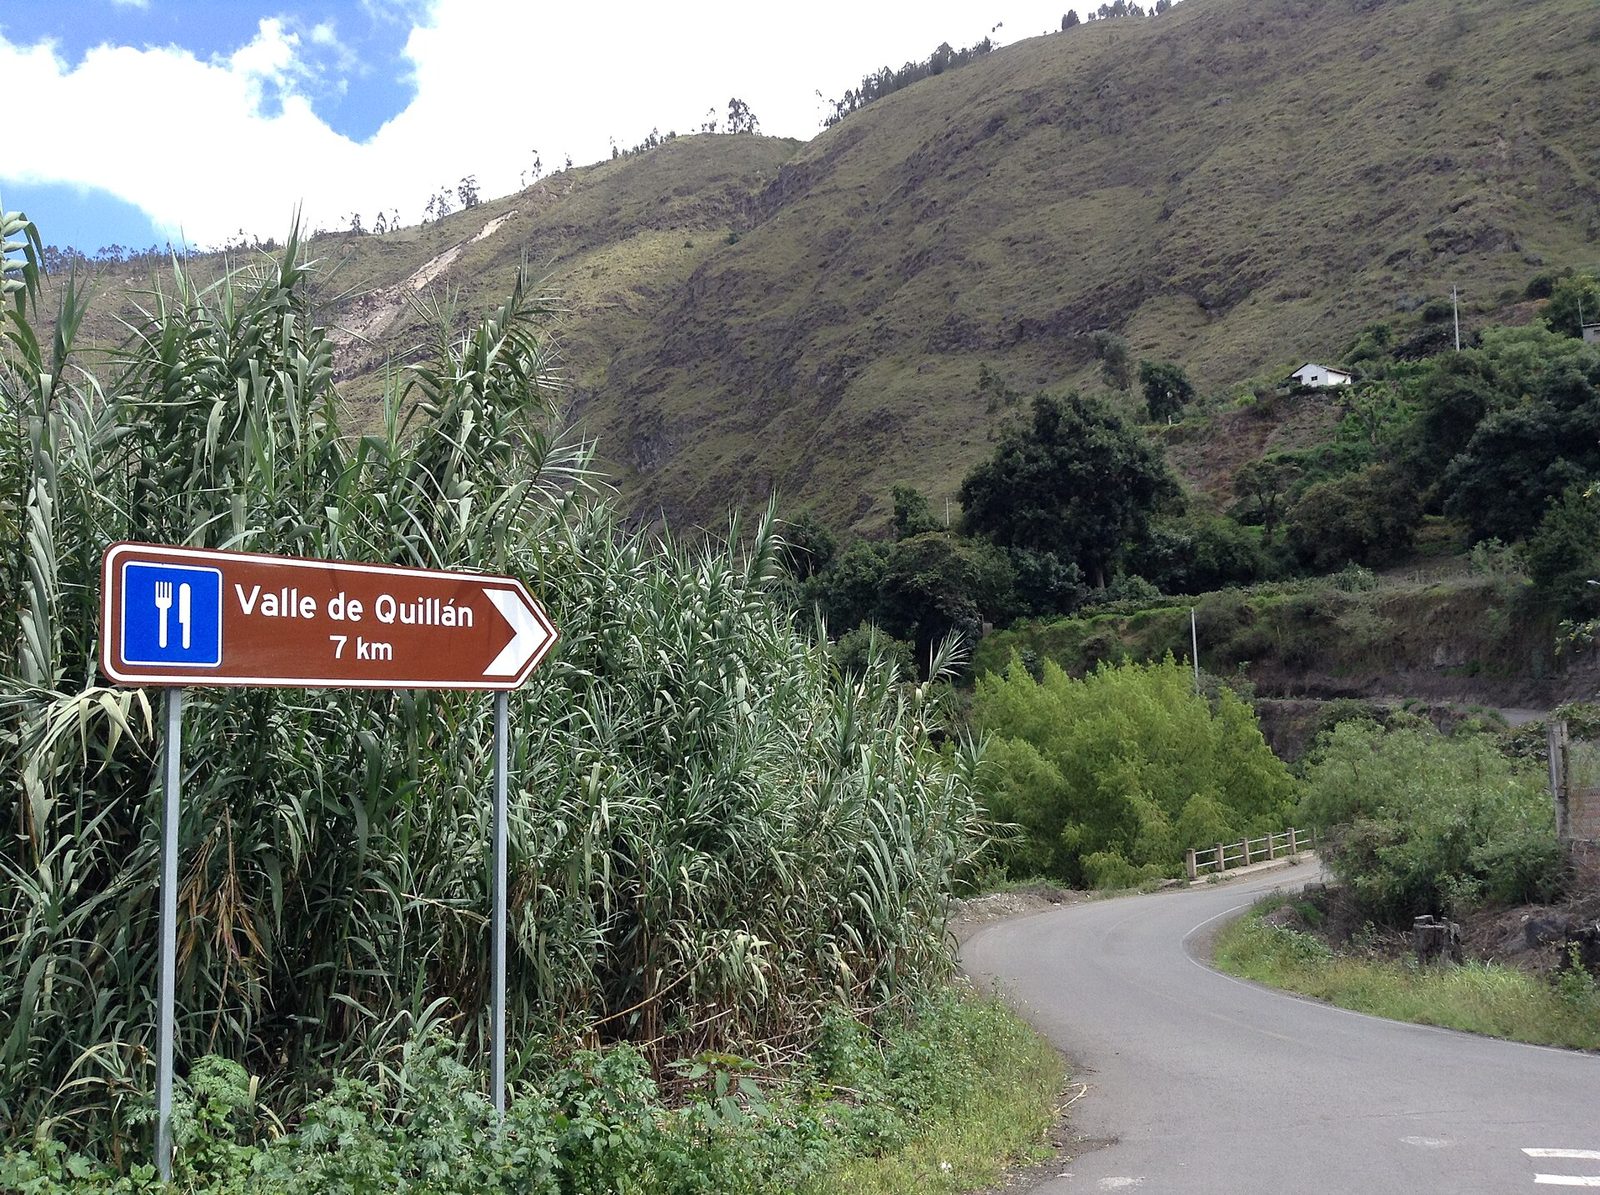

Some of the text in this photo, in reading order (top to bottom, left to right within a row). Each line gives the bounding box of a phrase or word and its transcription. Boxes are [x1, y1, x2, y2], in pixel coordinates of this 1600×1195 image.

[234, 583, 474, 628] Valle de Quillán
[329, 634, 393, 661] 7 km
